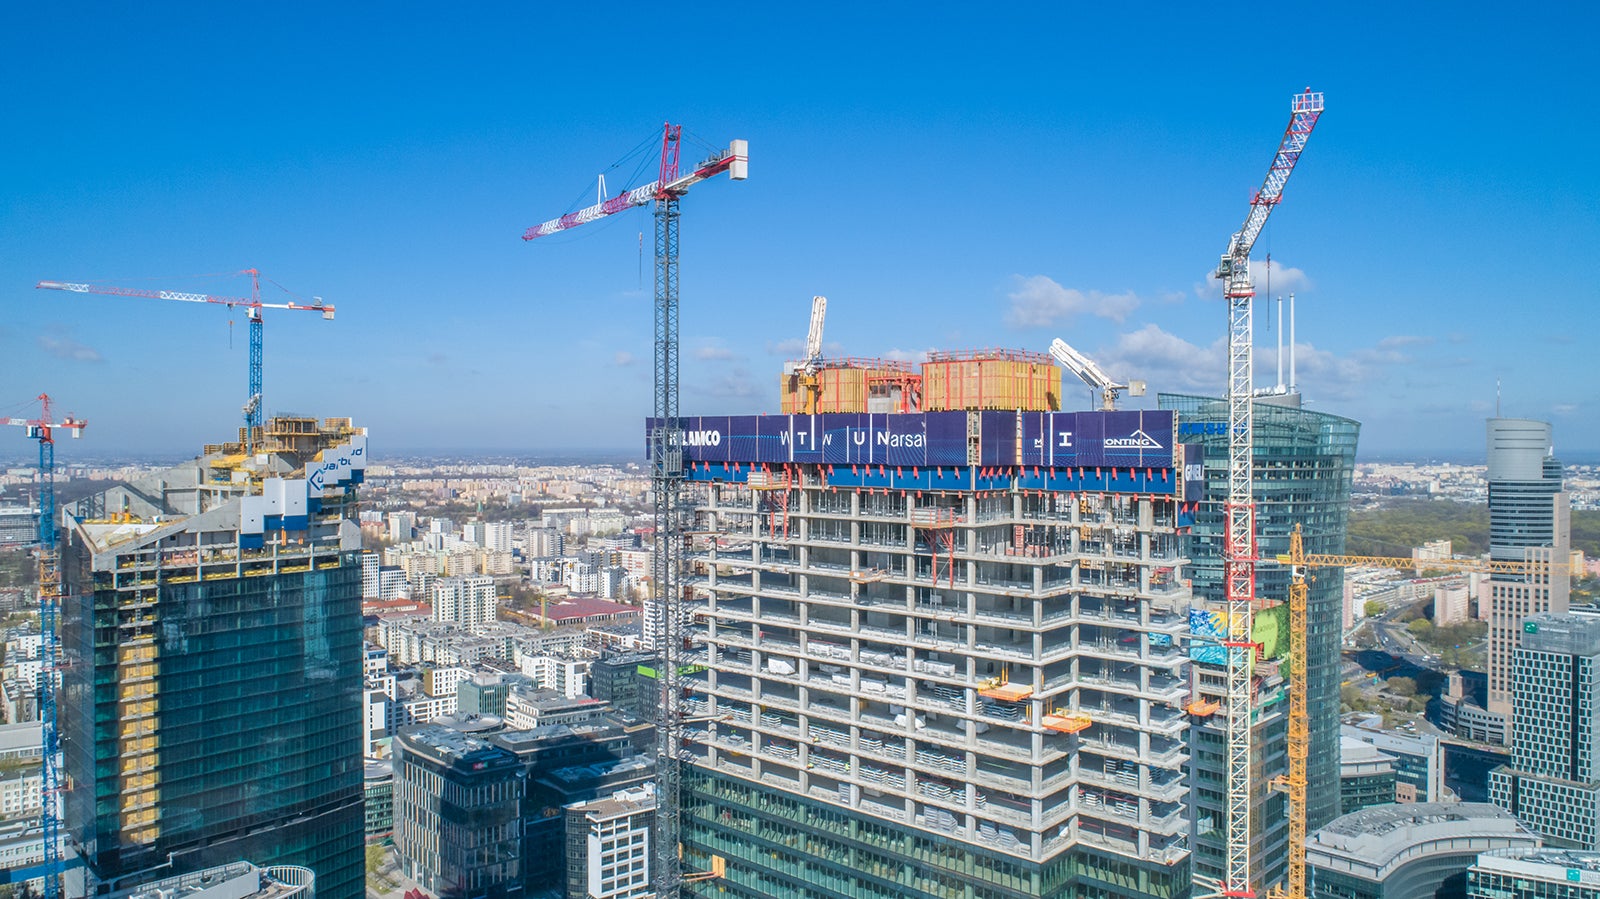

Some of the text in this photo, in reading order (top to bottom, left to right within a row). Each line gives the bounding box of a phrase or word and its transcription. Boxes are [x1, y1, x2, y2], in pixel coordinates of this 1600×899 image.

[1180, 422, 1247, 435] AMSU
[797, 431, 808, 445] T
[854, 431, 865, 446] U
[1104, 438, 1150, 446] ONTING
